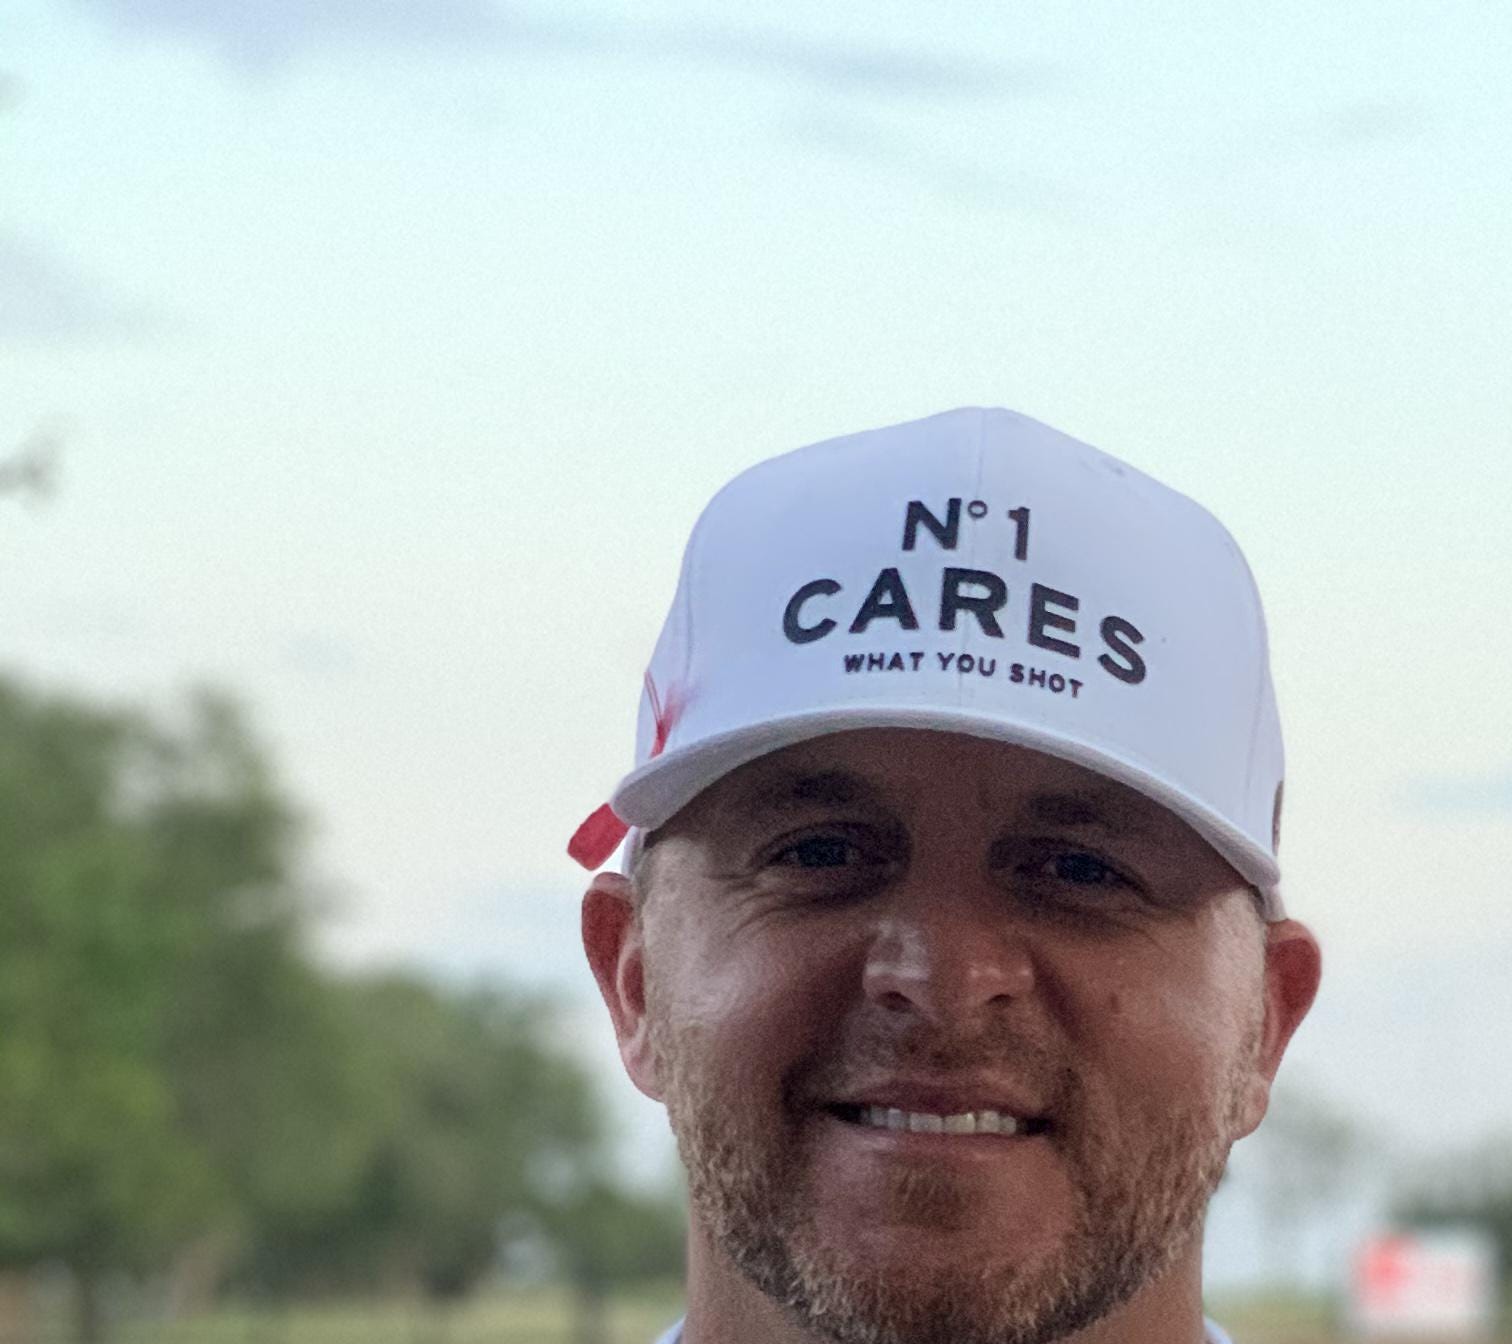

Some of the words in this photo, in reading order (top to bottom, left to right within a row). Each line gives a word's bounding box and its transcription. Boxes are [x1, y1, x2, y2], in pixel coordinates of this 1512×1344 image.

[1008, 506, 1031, 561] 1
[782, 566, 1148, 686] CARES
[843, 651, 926, 674] WHAT
[937, 651, 997, 678] YOU
[1009, 662, 1084, 699] SHOT
